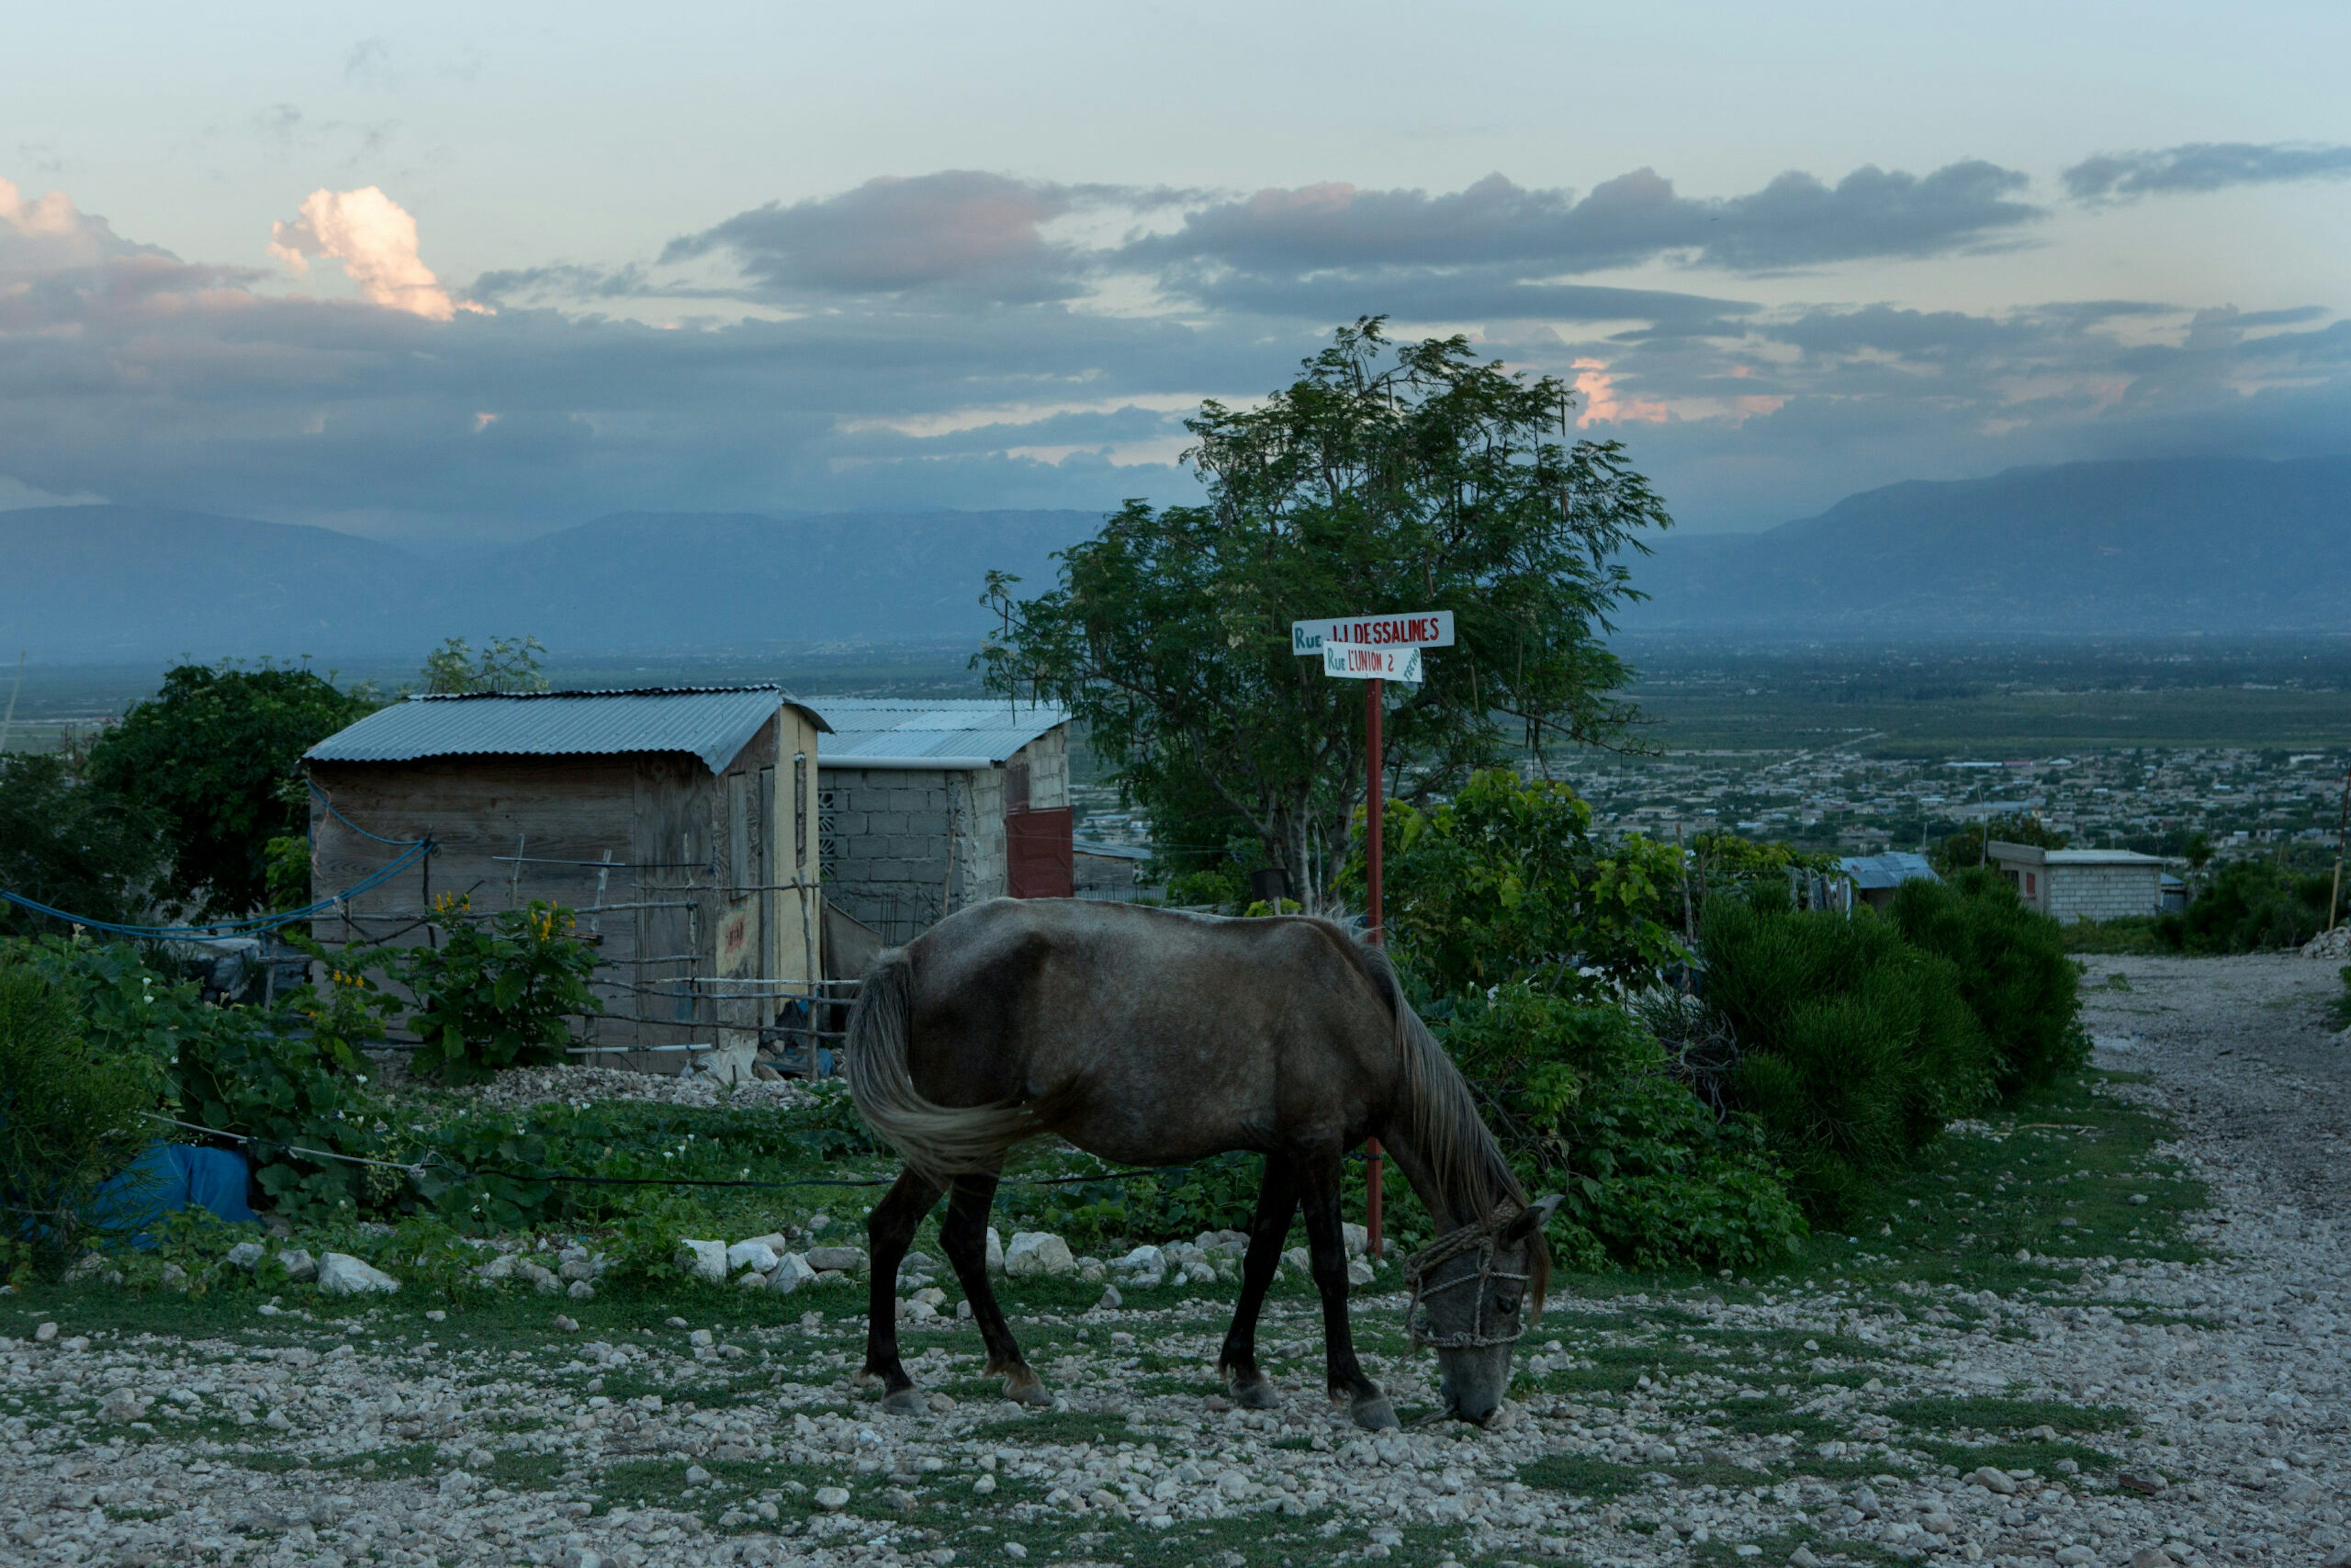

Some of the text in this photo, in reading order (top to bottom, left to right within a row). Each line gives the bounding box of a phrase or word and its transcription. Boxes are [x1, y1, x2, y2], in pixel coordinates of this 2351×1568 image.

[1354, 618, 1439, 644] DESSALINES
[1348, 650, 1382, 671] L'UNION
[1387, 654, 1394, 672] 2
